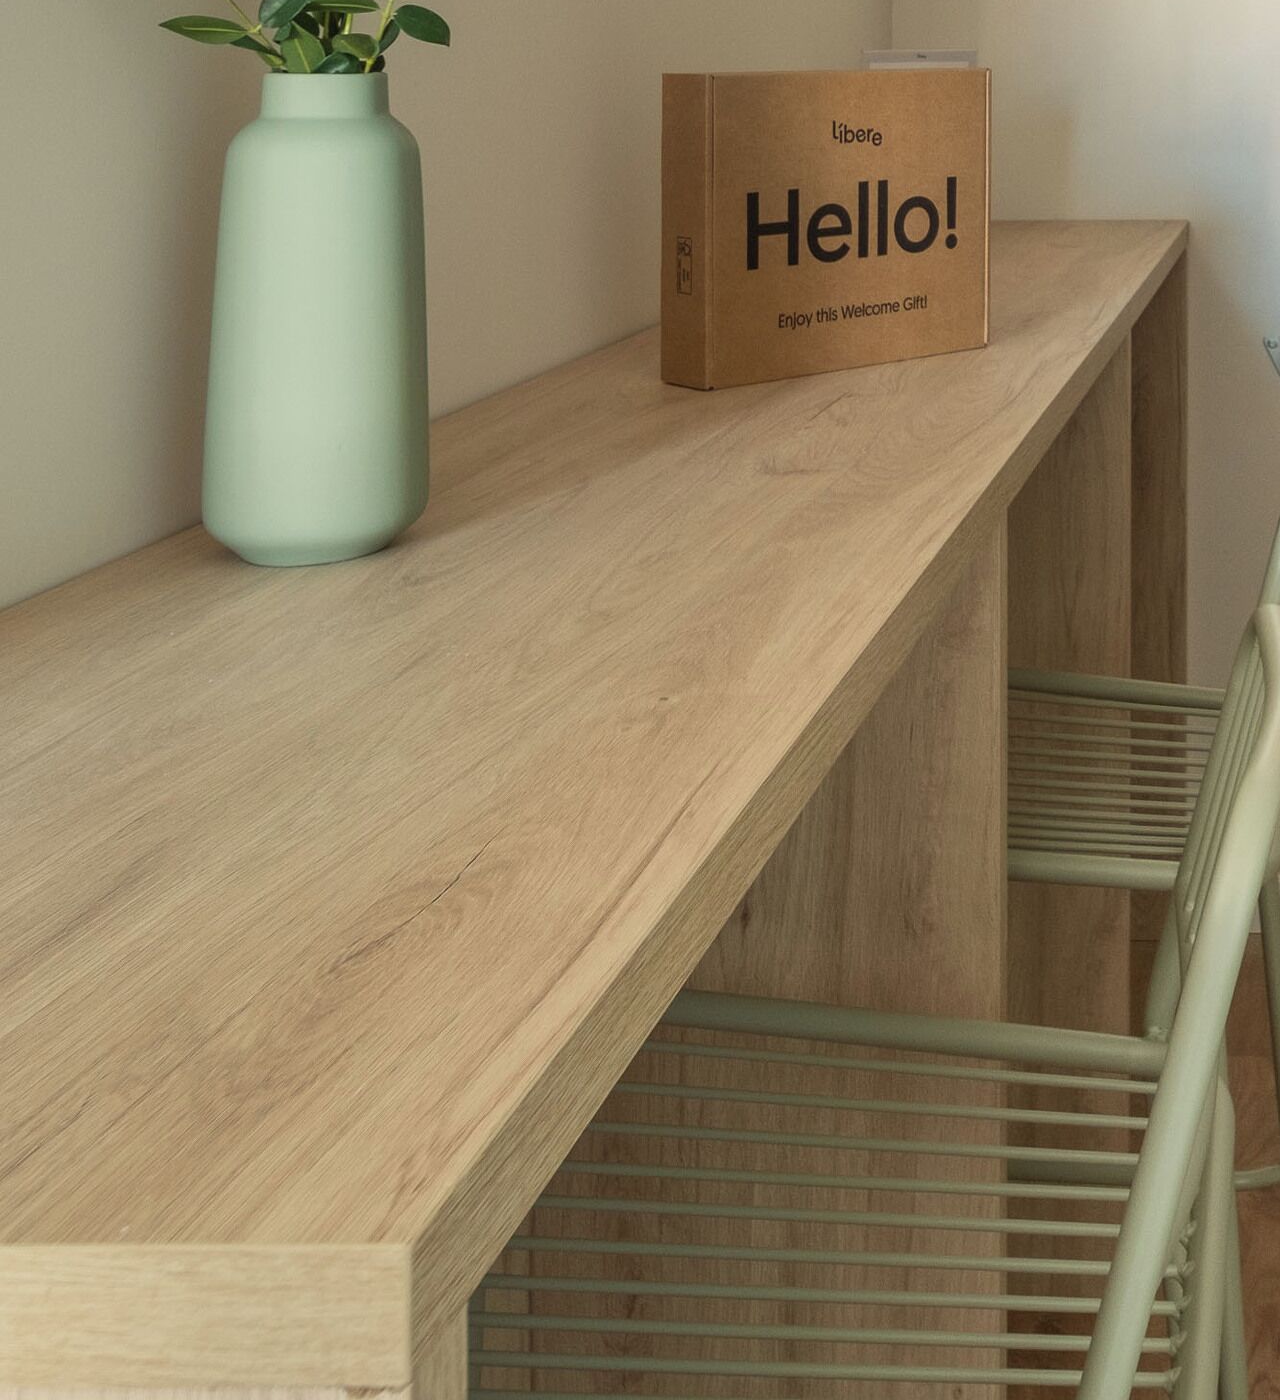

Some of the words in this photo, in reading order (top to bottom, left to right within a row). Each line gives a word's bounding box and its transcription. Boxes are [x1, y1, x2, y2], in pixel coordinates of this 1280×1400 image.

[746, 176, 958, 271] Hello!
[777, 311, 814, 331] Enjoy
[815, 308, 839, 325] this
[840, 302, 901, 320] Welcome
[902, 295, 929, 311] Gift!
